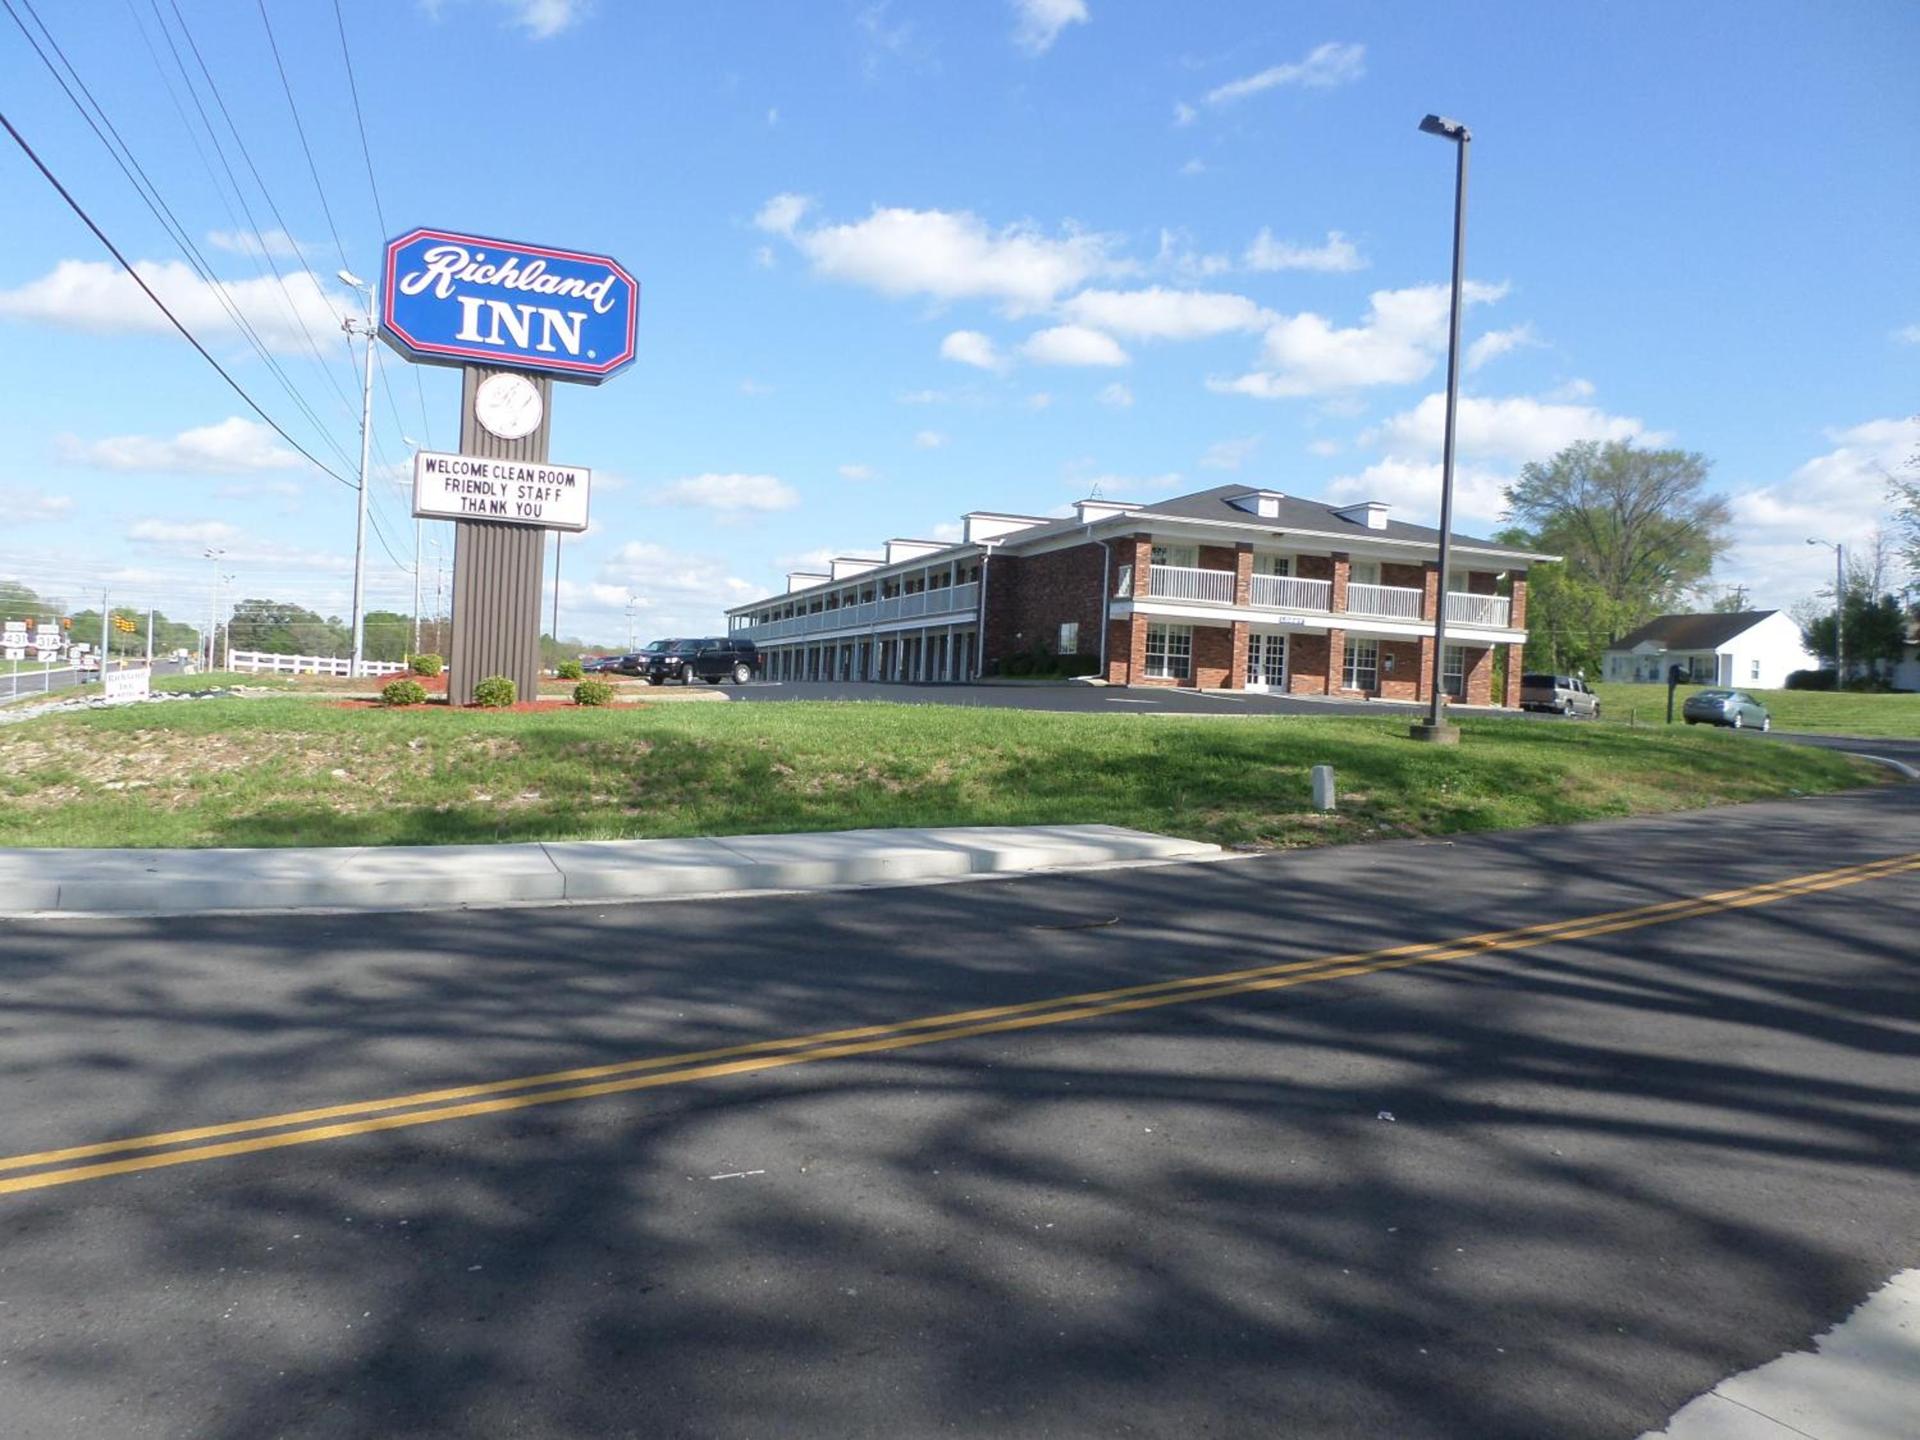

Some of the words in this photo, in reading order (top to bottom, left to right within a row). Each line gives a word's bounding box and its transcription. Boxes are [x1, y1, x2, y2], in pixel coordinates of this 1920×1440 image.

[400, 245, 615, 314] Richland
[455, 295, 588, 355] INN
[426, 458, 489, 478] WELCOME
[493, 465, 534, 482] CLEAN
[538, 470, 576, 488] ROOM
[445, 478, 508, 497] FRIENDLY
[518, 485, 562, 502] STAFF
[461, 497, 508, 514] THANK
[516, 502, 543, 518] YOU
[38, 637, 59, 647] 31A
